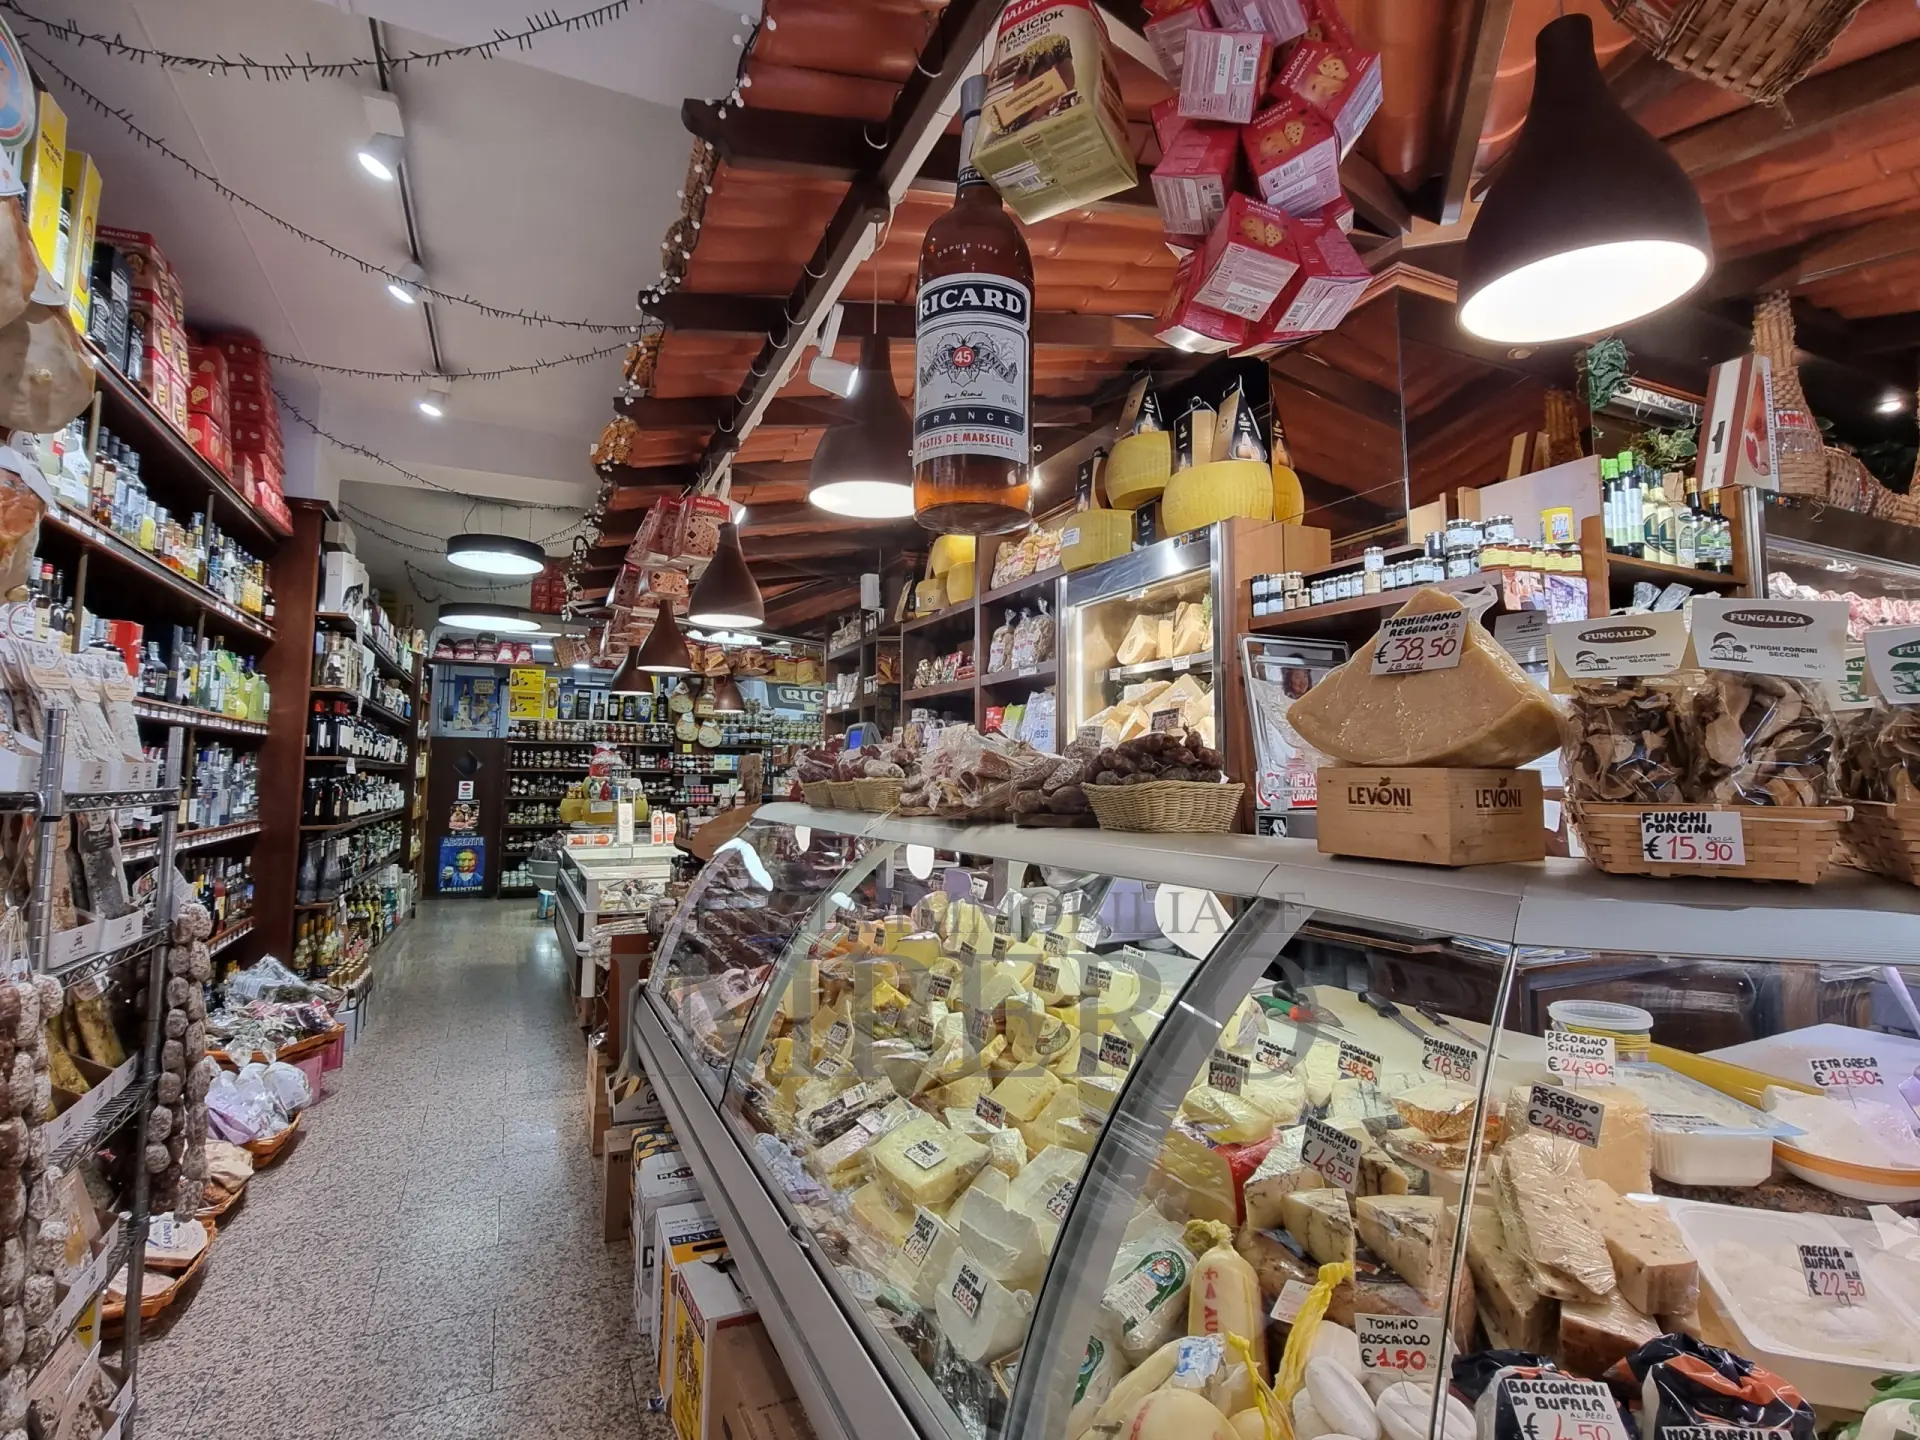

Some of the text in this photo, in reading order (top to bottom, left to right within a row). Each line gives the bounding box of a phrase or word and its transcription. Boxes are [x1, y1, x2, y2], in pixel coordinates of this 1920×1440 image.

[919, 287, 1022, 319] RICARD
[954, 350, 972, 363] 45
[922, 411, 1011, 428] FRANCE
[919, 436, 943, 448] PASTIS
[946, 434, 959, 443] DE
[962, 432, 1015, 447] MARSEILLE
[1384, 611, 1462, 629] PARMIGIANO
[1730, 613, 1806, 625] FUNGALICA
[1389, 622, 1449, 638] REGGIANO
[1583, 629, 1650, 642] FUNGALICA
[1374, 640, 1390, 664] €
[1750, 644, 1818, 654] FUNGHI PORCINI
[1768, 651, 1800, 659] SECCHI
[1347, 786, 1412, 807] LEVONI
[1476, 788, 1522, 809] LEVONI
[1642, 812, 1707, 824] FUNGHI
[1645, 823, 1712, 834] PORCINI
[1643, 835, 1733, 861] € 15.90
[440, 885, 483, 893] ABSINTHE
[1423, 1036, 1479, 1061] GORGONZOLA
[1338, 1056, 1347, 1070] €
[1422, 1053, 1433, 1070] €
[1547, 1056, 1561, 1071] €
[1811, 1057, 1878, 1071] FETA GRECA
[1813, 1071, 1830, 1086] €
[1532, 1085, 1599, 1115] PECORINO
[1532, 1094, 1582, 1118] PEPATO
[1528, 1109, 1543, 1127] €
[1306, 1117, 1358, 1150] MOLITERNO
[1301, 1139, 1313, 1164] €
[1316, 1133, 1348, 1153] TARTUFO
[1799, 1244, 1840, 1258] TRECCIA
[1803, 1256, 1845, 1270] BUFALA
[1808, 1270, 1822, 1296] €
[1361, 1347, 1377, 1368] €
[1507, 1379, 1607, 1397] BOCCONCINI
[1534, 1396, 1606, 1412] BUFALA
